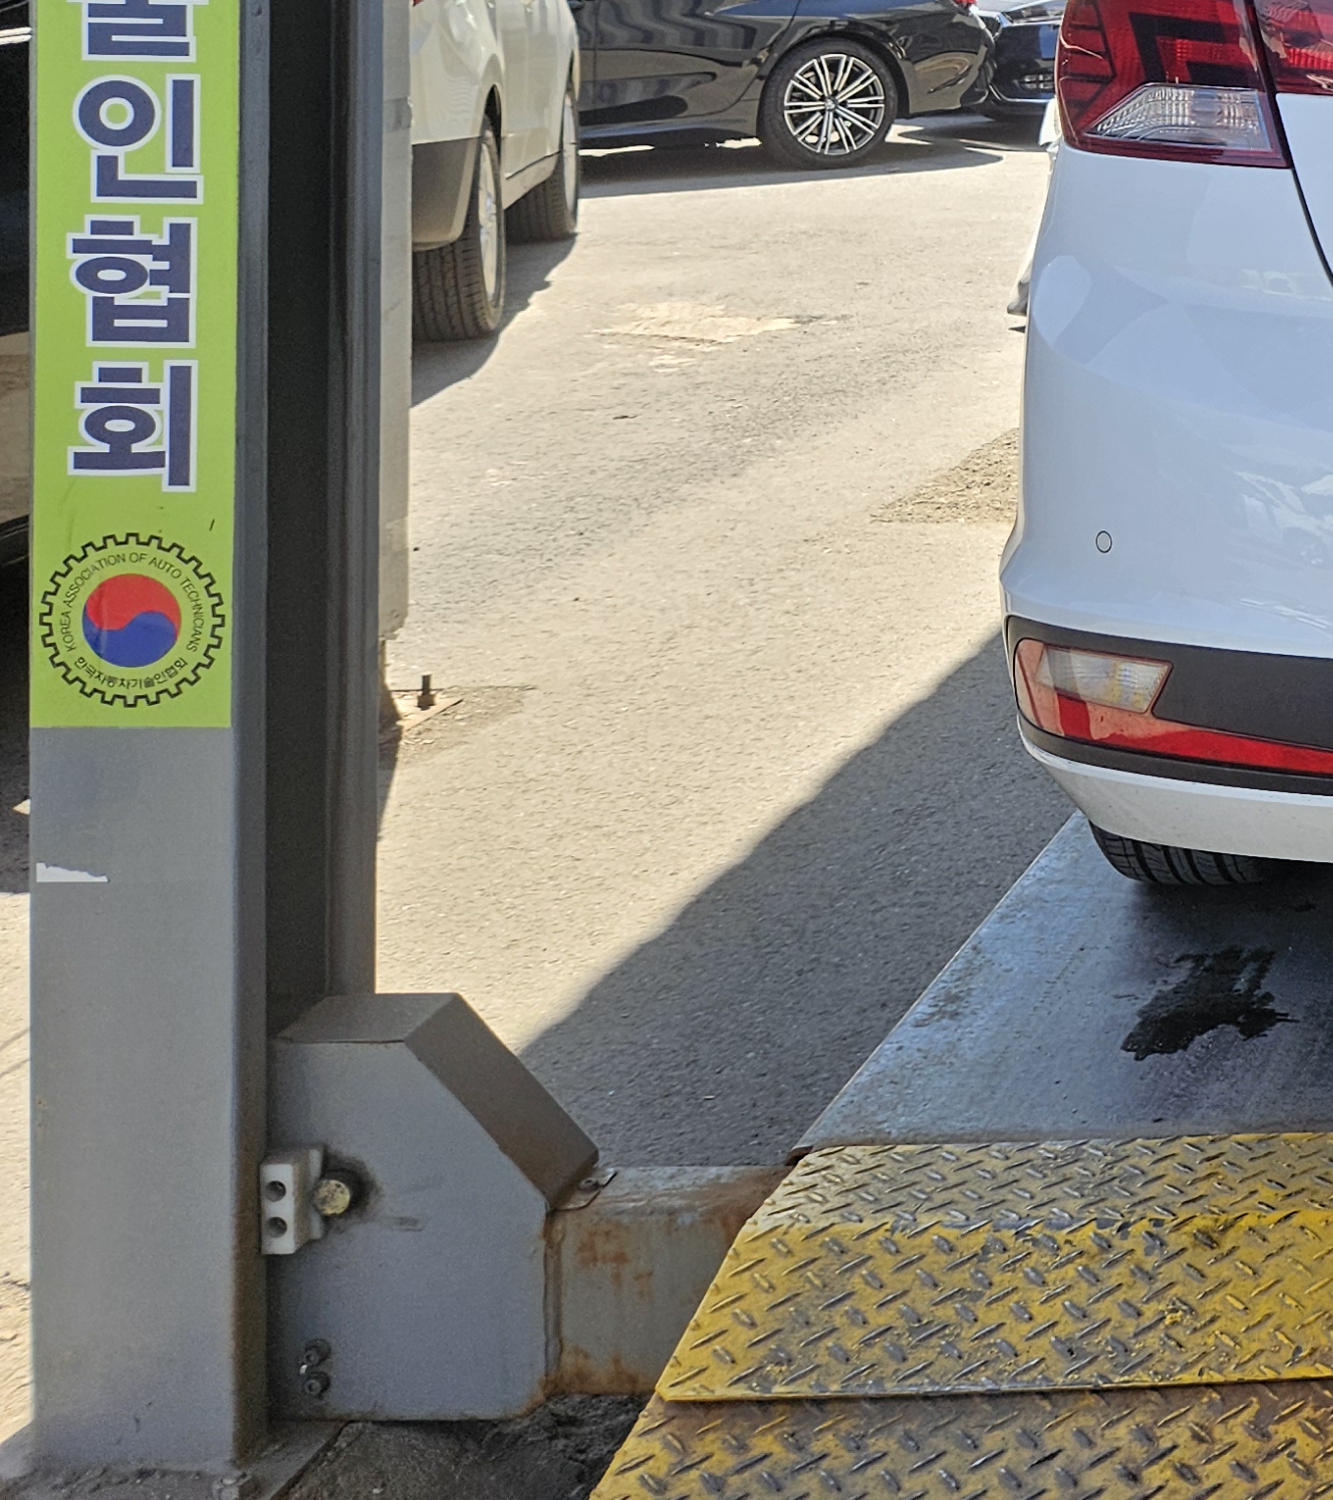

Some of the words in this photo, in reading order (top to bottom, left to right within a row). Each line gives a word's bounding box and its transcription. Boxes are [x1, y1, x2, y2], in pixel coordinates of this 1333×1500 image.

[129, 552, 148, 563] OF
[150, 557, 182, 580] AUTO
[63, 553, 126, 609] ASSOCIATION
[59, 610, 78, 653] KOREA
[180, 577, 205, 653] TECHNICIANS
